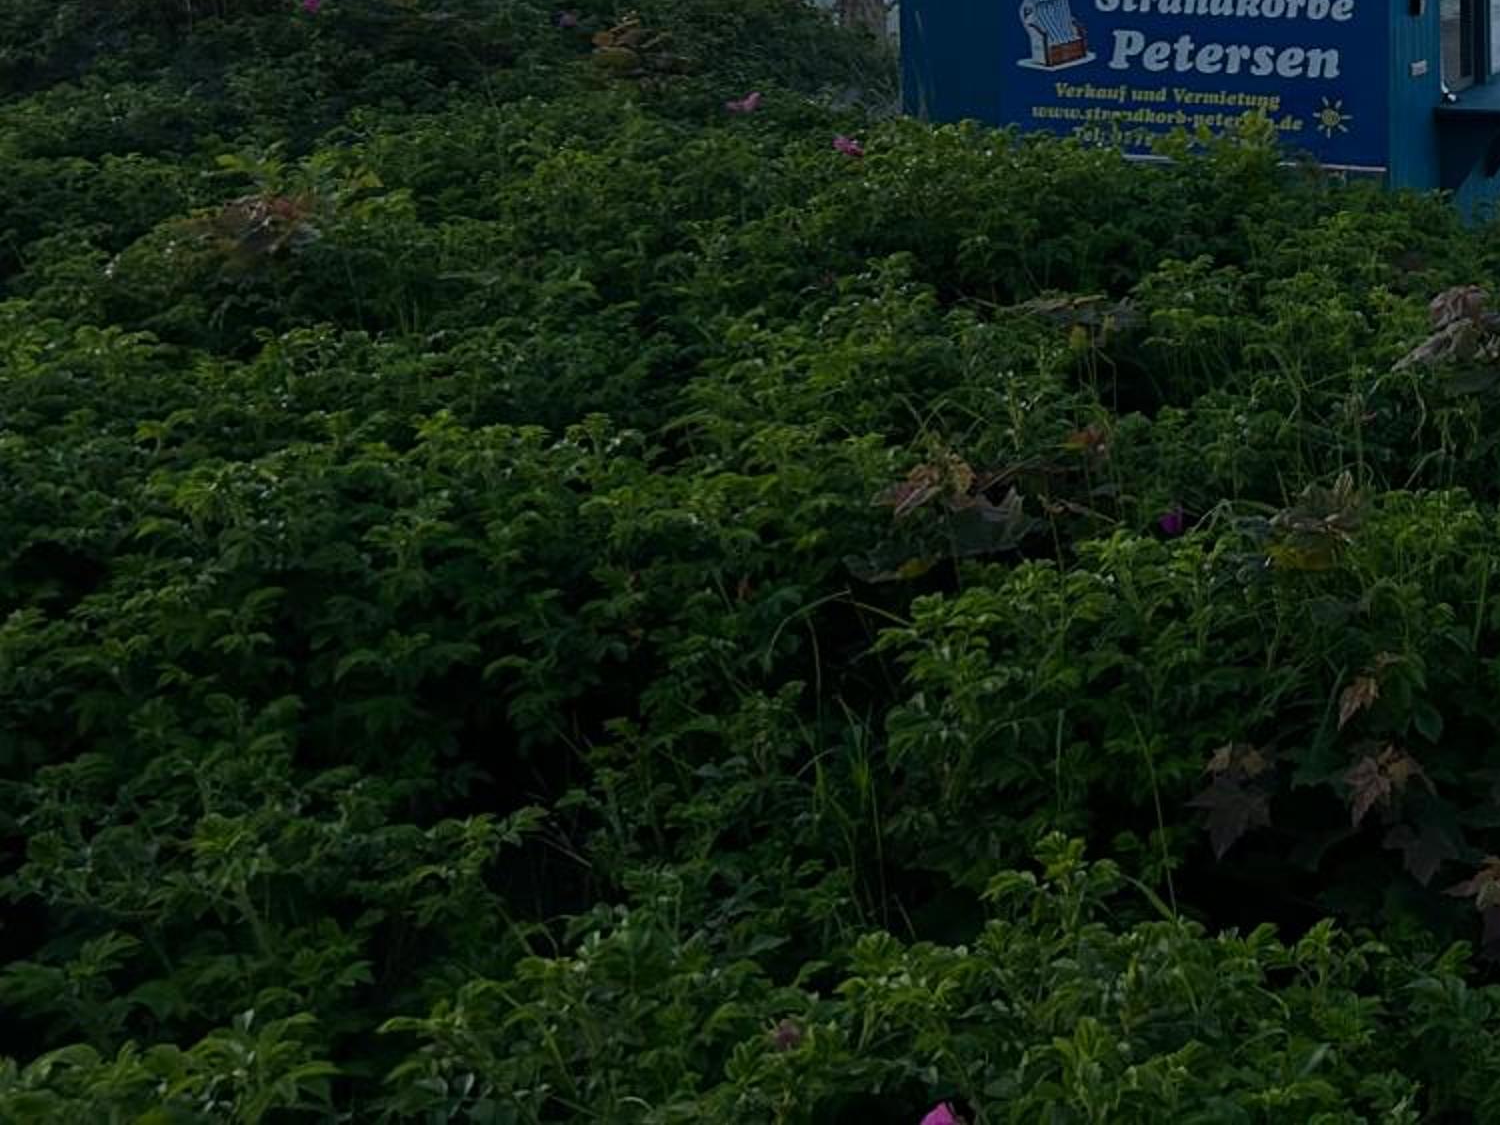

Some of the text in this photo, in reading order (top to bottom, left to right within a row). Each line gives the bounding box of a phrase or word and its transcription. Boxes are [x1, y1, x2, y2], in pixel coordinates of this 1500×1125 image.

[1108, 29, 1340, 78] Petersen
[1055, 83, 1280, 110] Verkauf und Vermietung
[1032, 106, 1303, 131] www.strndkorb-petern.de
